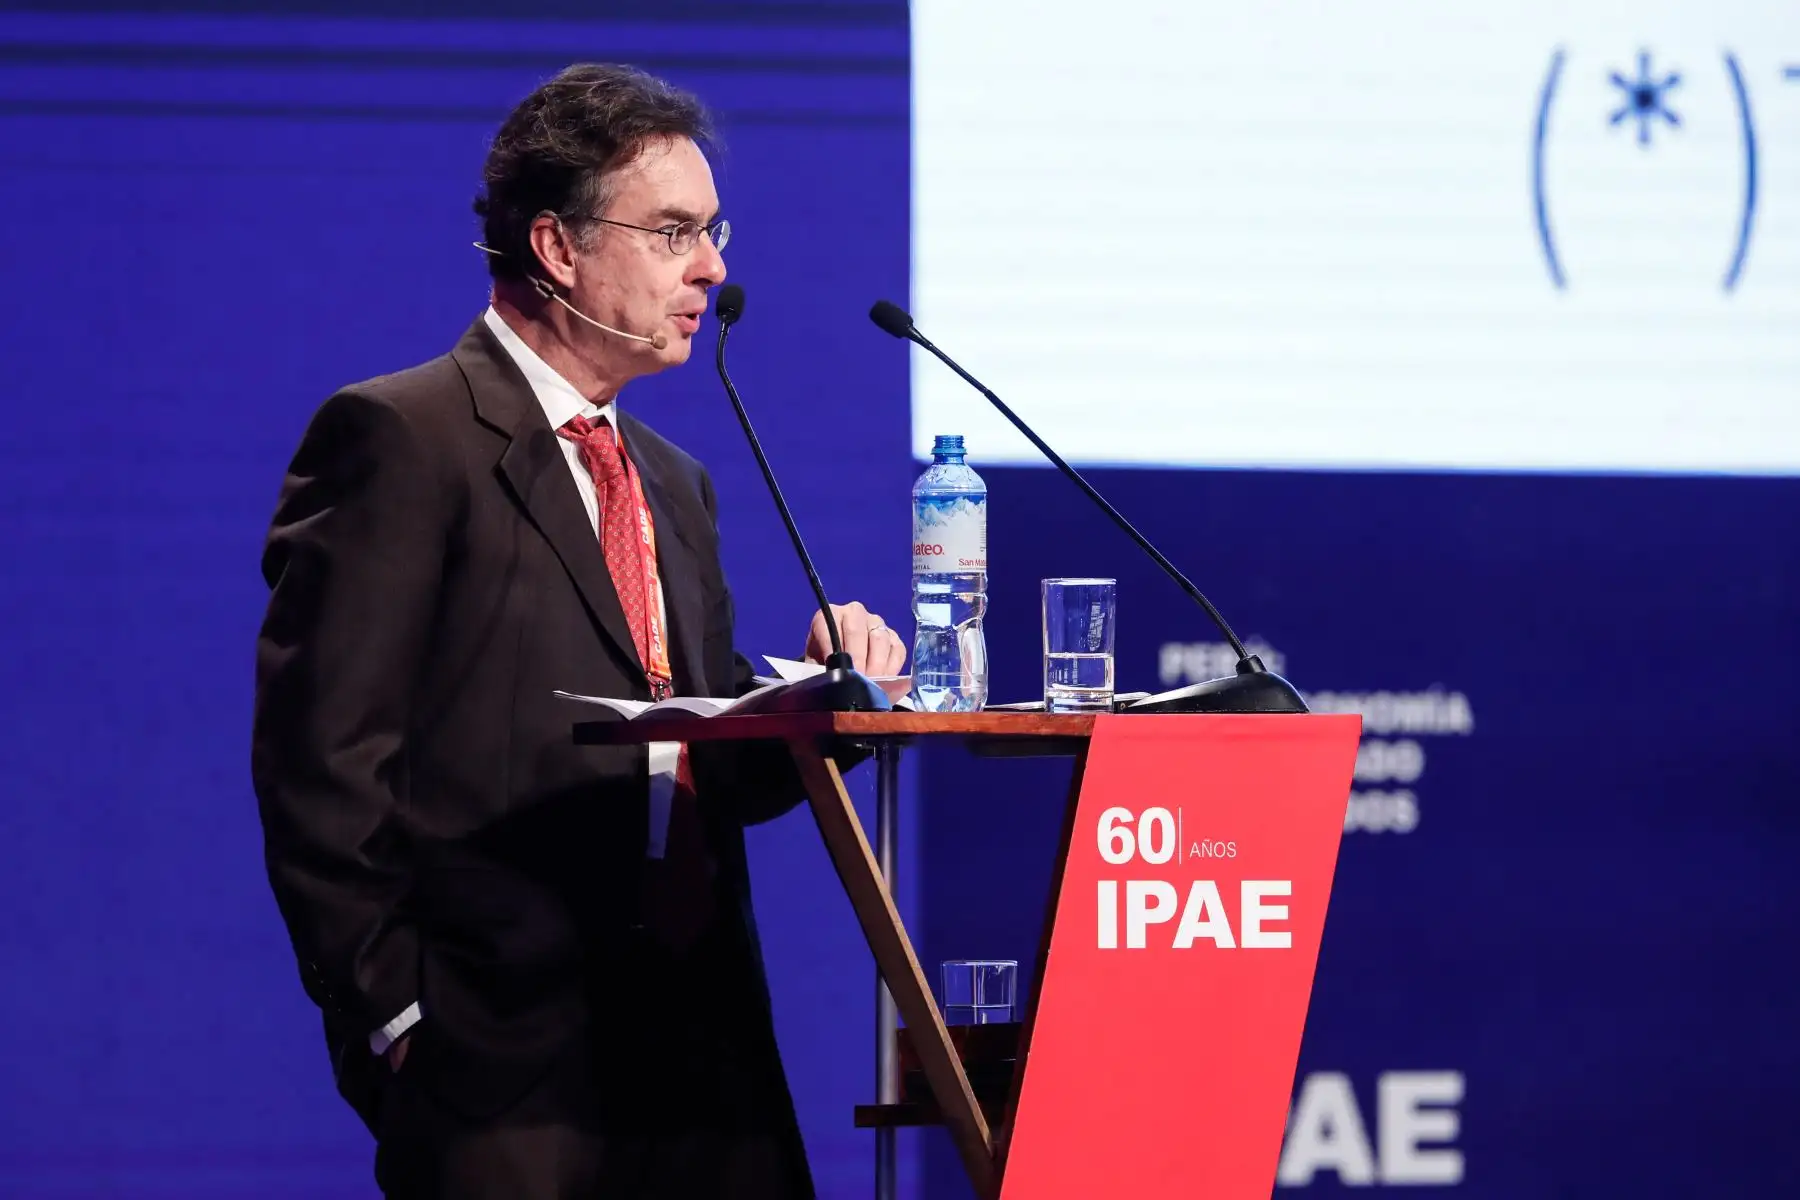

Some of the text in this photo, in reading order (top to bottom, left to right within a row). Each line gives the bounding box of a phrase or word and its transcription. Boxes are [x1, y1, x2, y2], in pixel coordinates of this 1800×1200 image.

[638, 506, 650, 545] CADE
[913, 541, 945, 556] ateo.
[958, 558, 974, 567] San
[650, 615, 662, 654] CADE
[1097, 806, 1237, 864] 60 AÑOS
[1097, 880, 1292, 949] IPAE
[1274, 1070, 1465, 1186] AE
